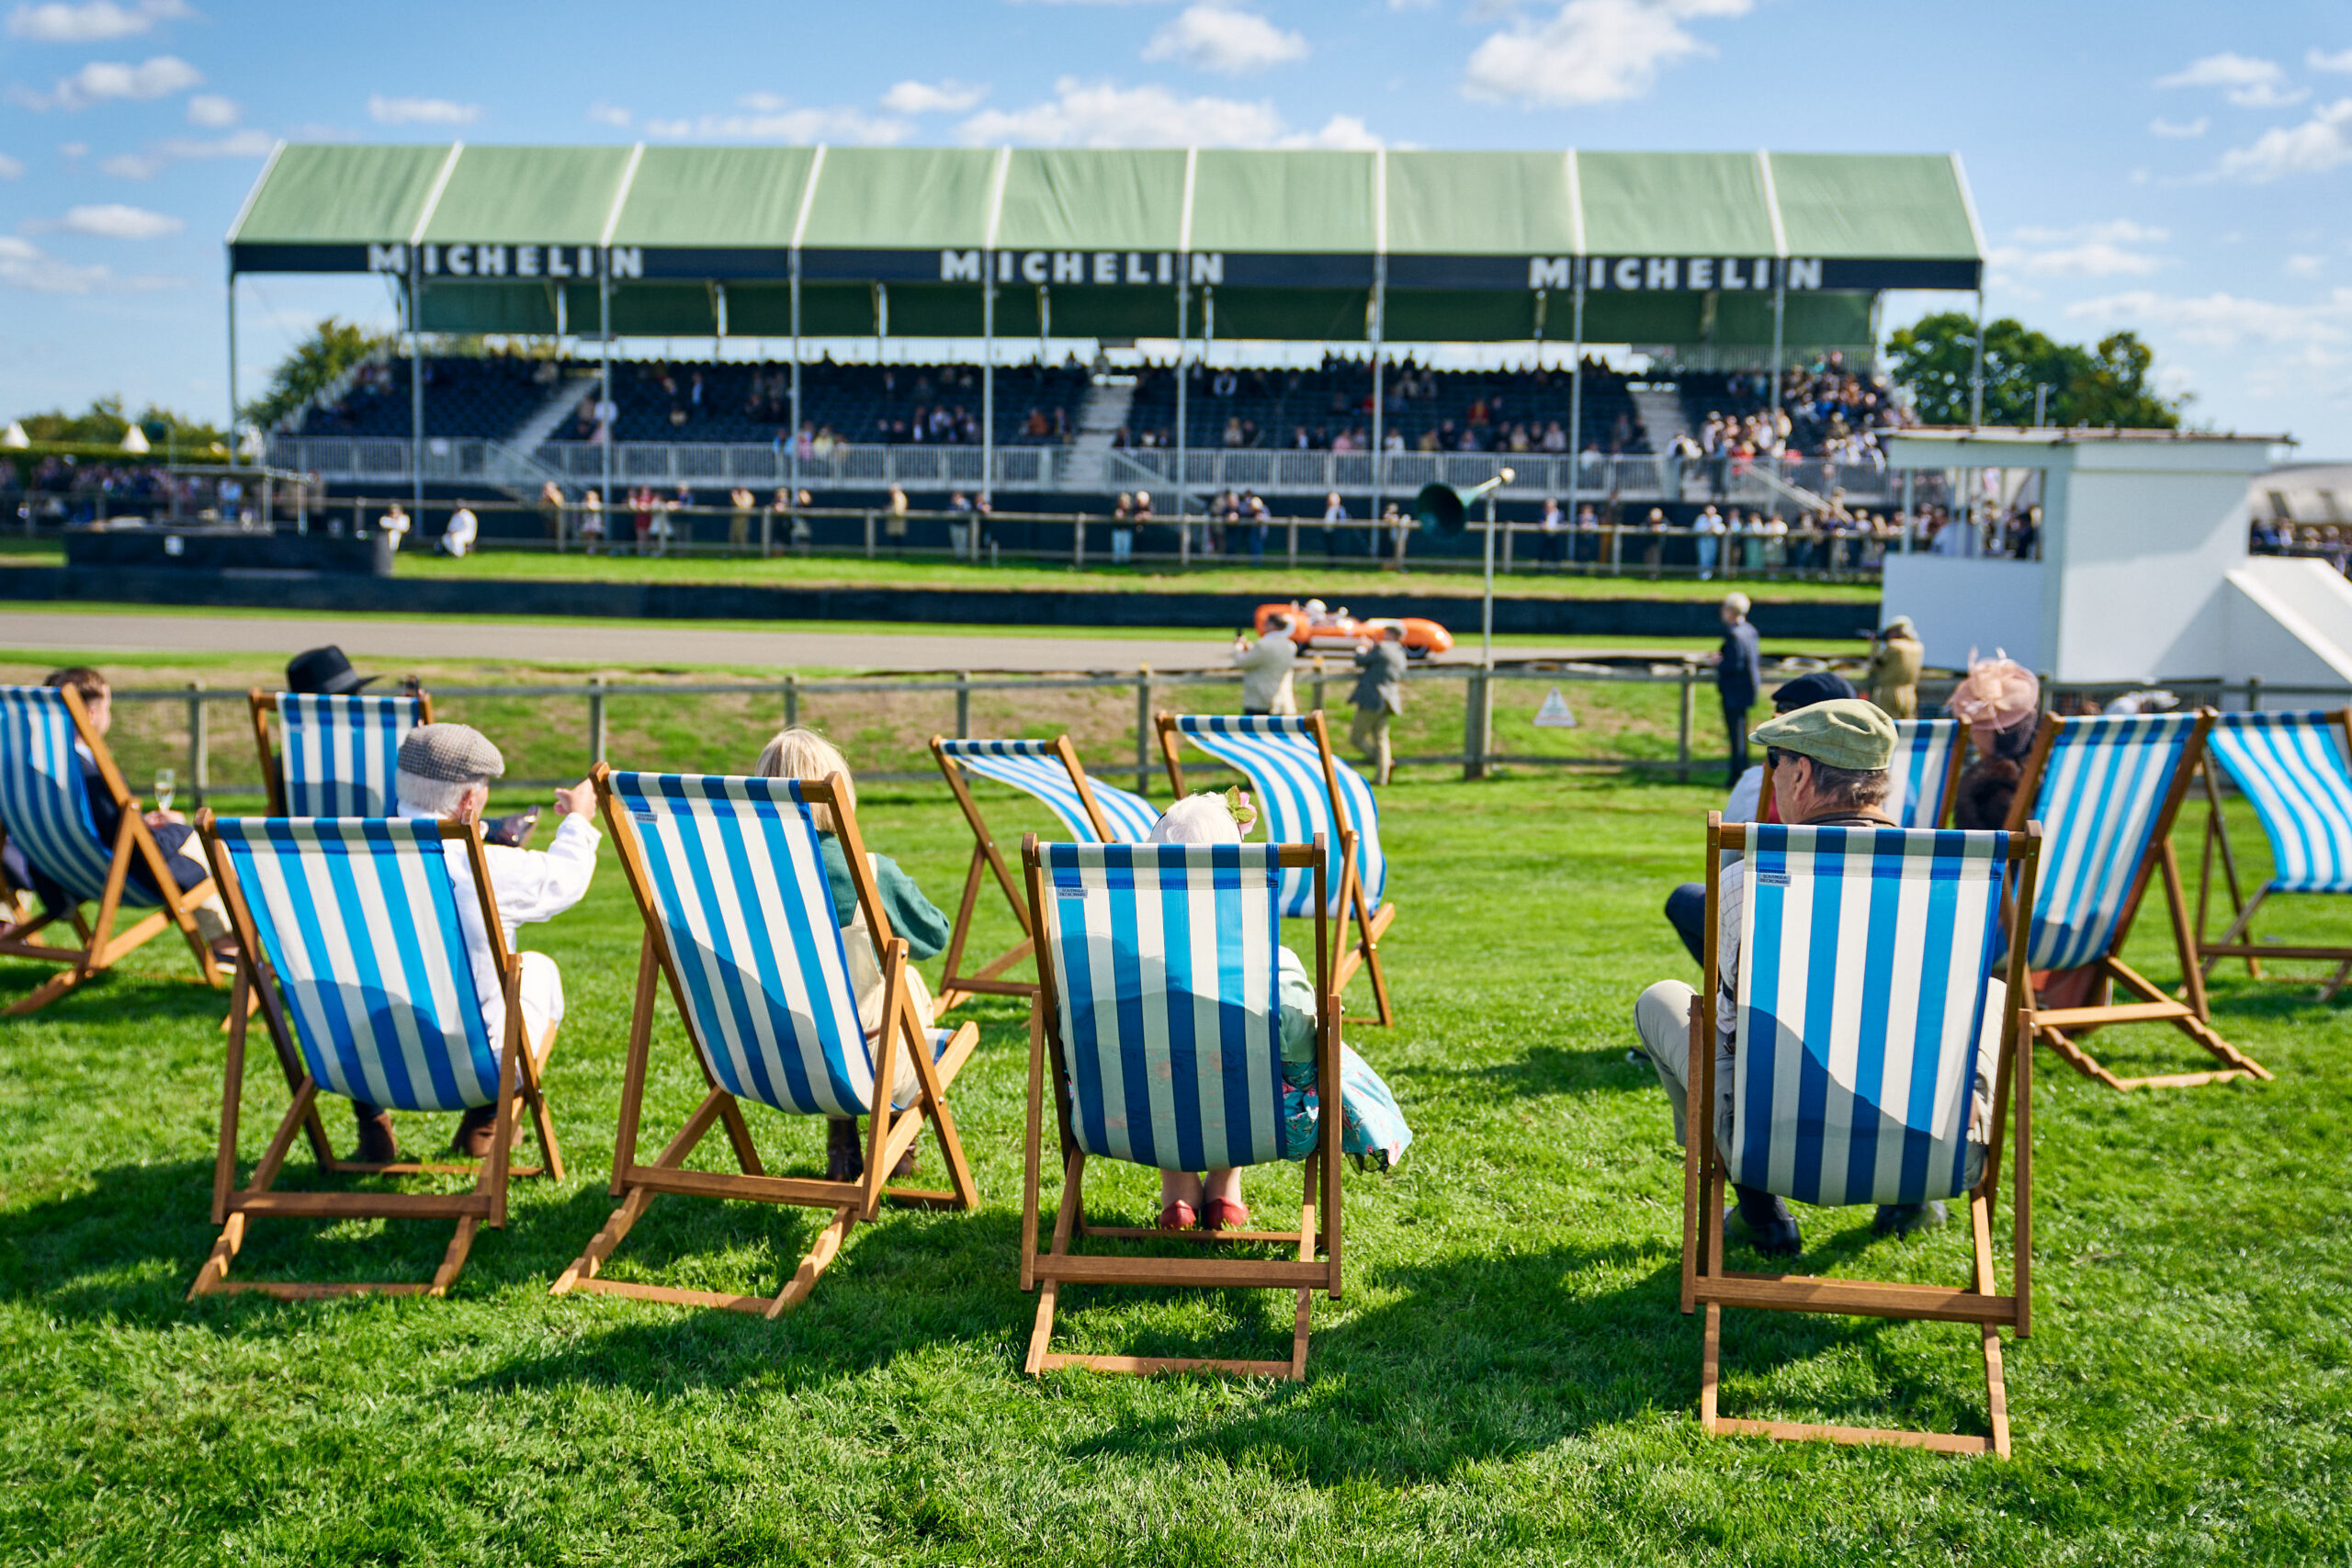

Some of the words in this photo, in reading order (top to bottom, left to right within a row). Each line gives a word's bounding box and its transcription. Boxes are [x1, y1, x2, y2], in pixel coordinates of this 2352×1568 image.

[368, 243, 643, 276] MICHELIN
[940, 250, 1224, 284] MICHELIN
[1528, 256, 1823, 290] MICHELIN
